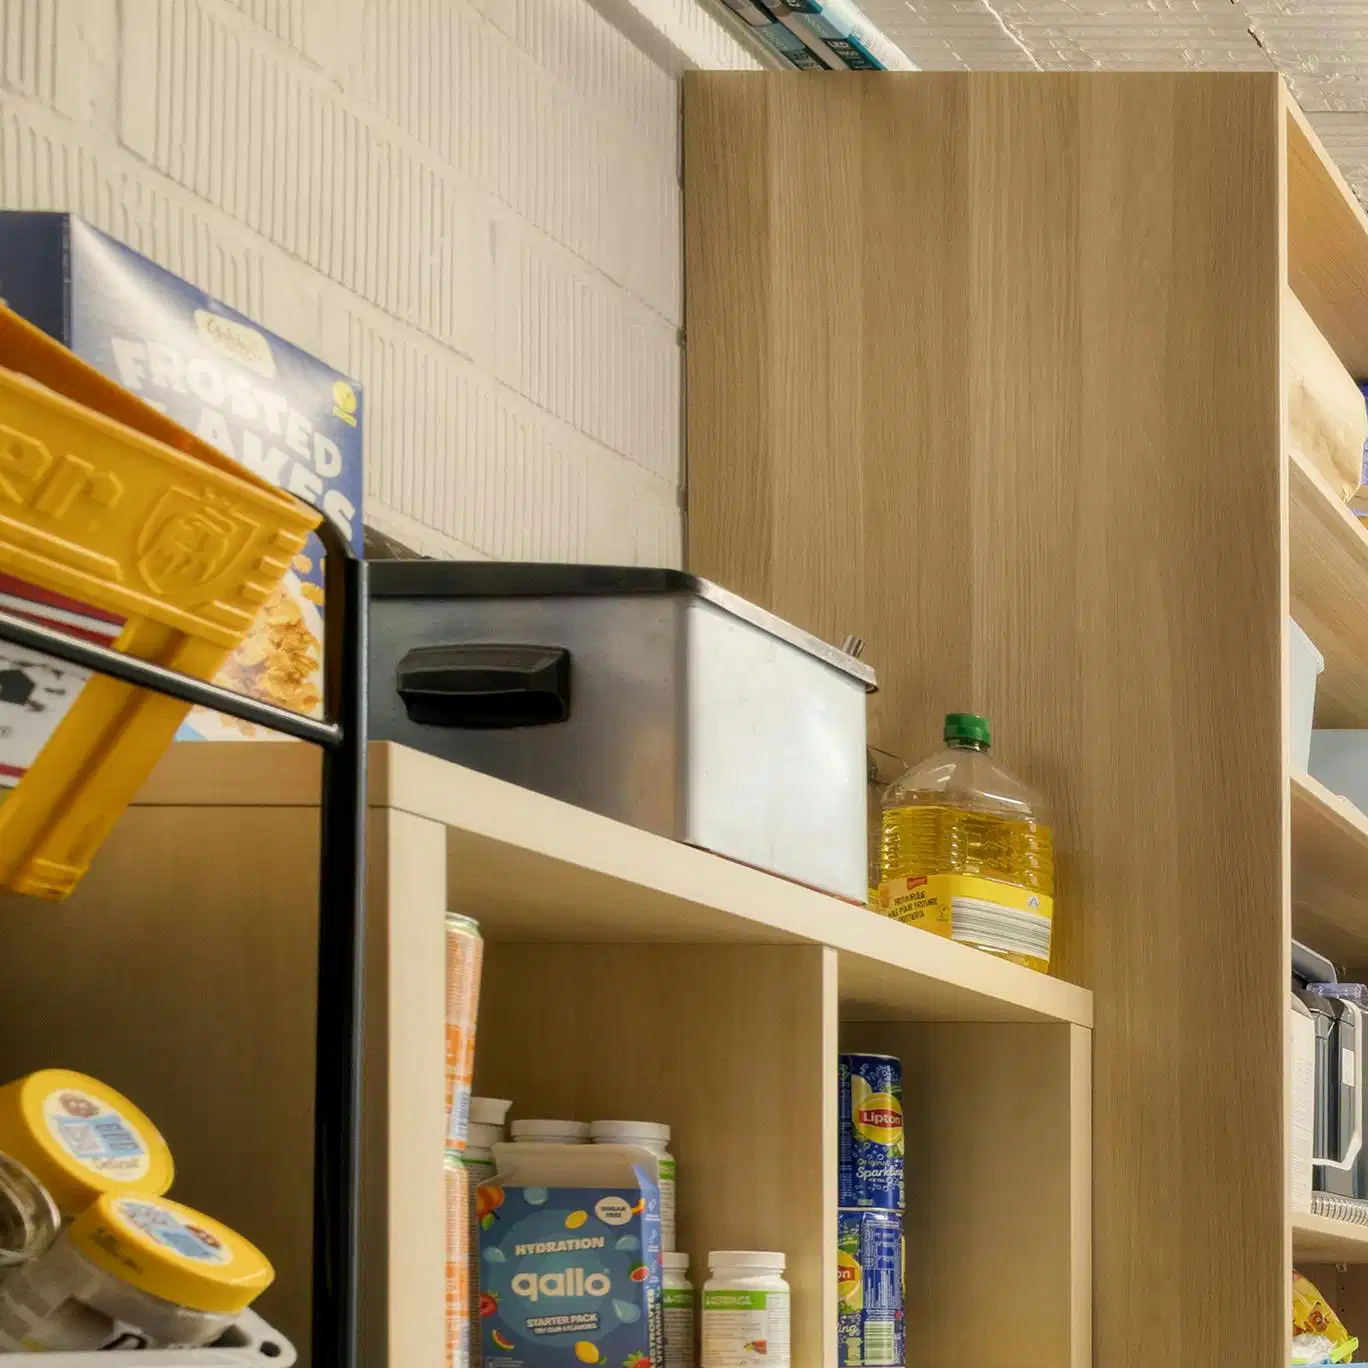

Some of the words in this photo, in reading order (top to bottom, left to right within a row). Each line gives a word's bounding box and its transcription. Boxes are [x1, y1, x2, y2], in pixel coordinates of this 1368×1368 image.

[111, 336, 343, 479] FROSTED
[862, 1111, 901, 1125] Lipton
[514, 1236, 606, 1257] HYDRATION
[511, 1267, 611, 1303] qallo
[526, 1314, 568, 1329] STARTER
[568, 1312, 599, 1324] PACK
